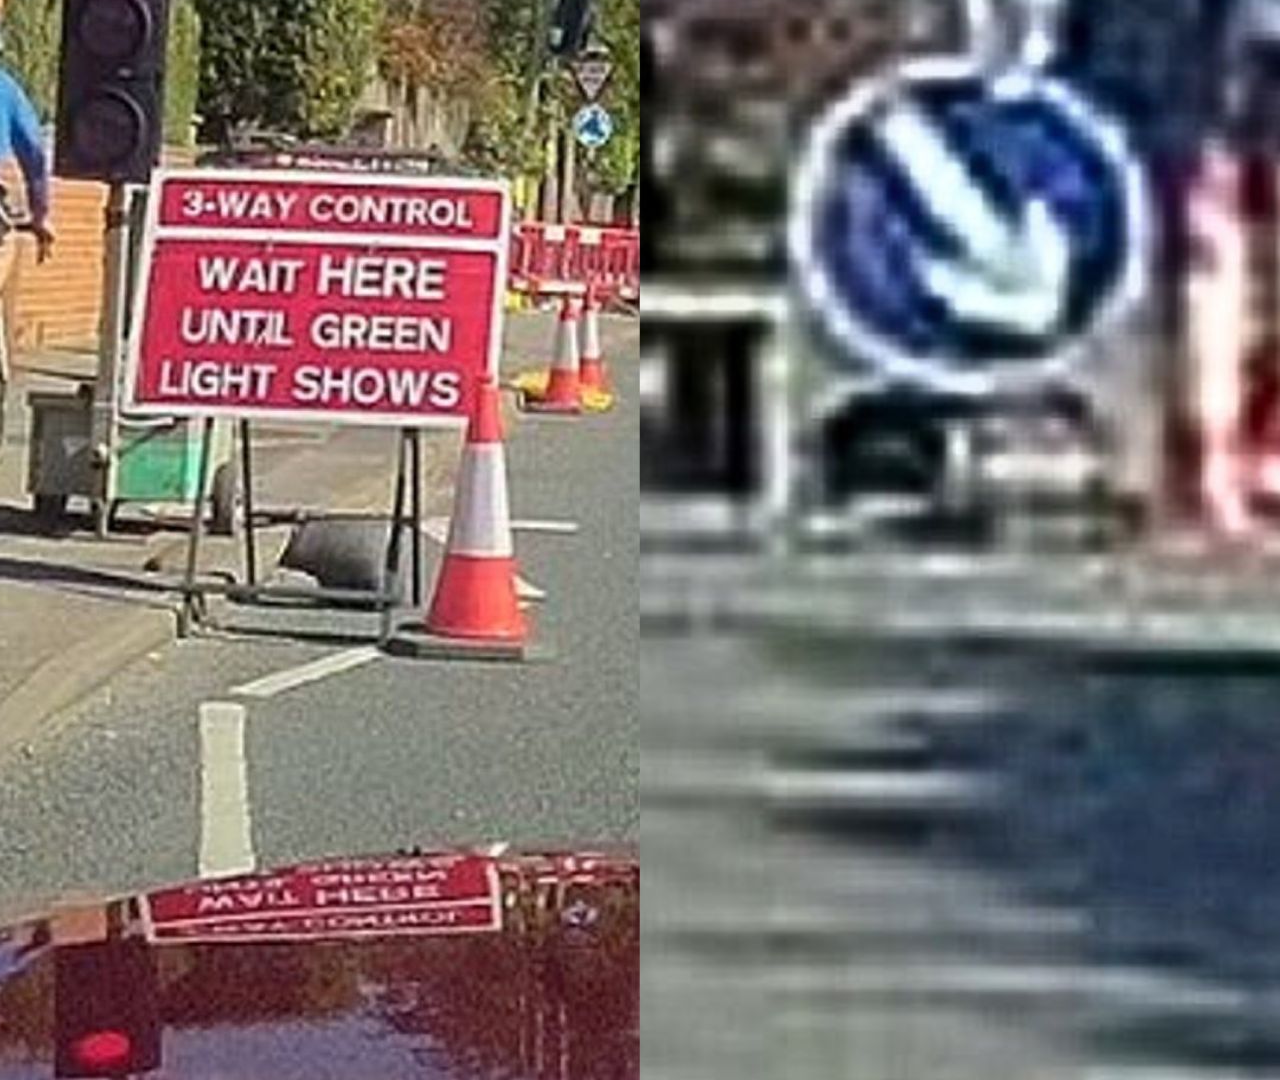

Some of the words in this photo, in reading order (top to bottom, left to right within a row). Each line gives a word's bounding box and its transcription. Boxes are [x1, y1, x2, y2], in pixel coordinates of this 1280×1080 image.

[182, 189, 298, 218] 3-WAY
[309, 195, 473, 227] CONTROL
[199, 257, 305, 293] WAIT
[319, 255, 447, 299] HERE
[182, 307, 294, 346] UNTIL
[310, 314, 452, 352] GREEN
[159, 361, 277, 398] LIGHT
[293, 369, 461, 408] SHOWS
